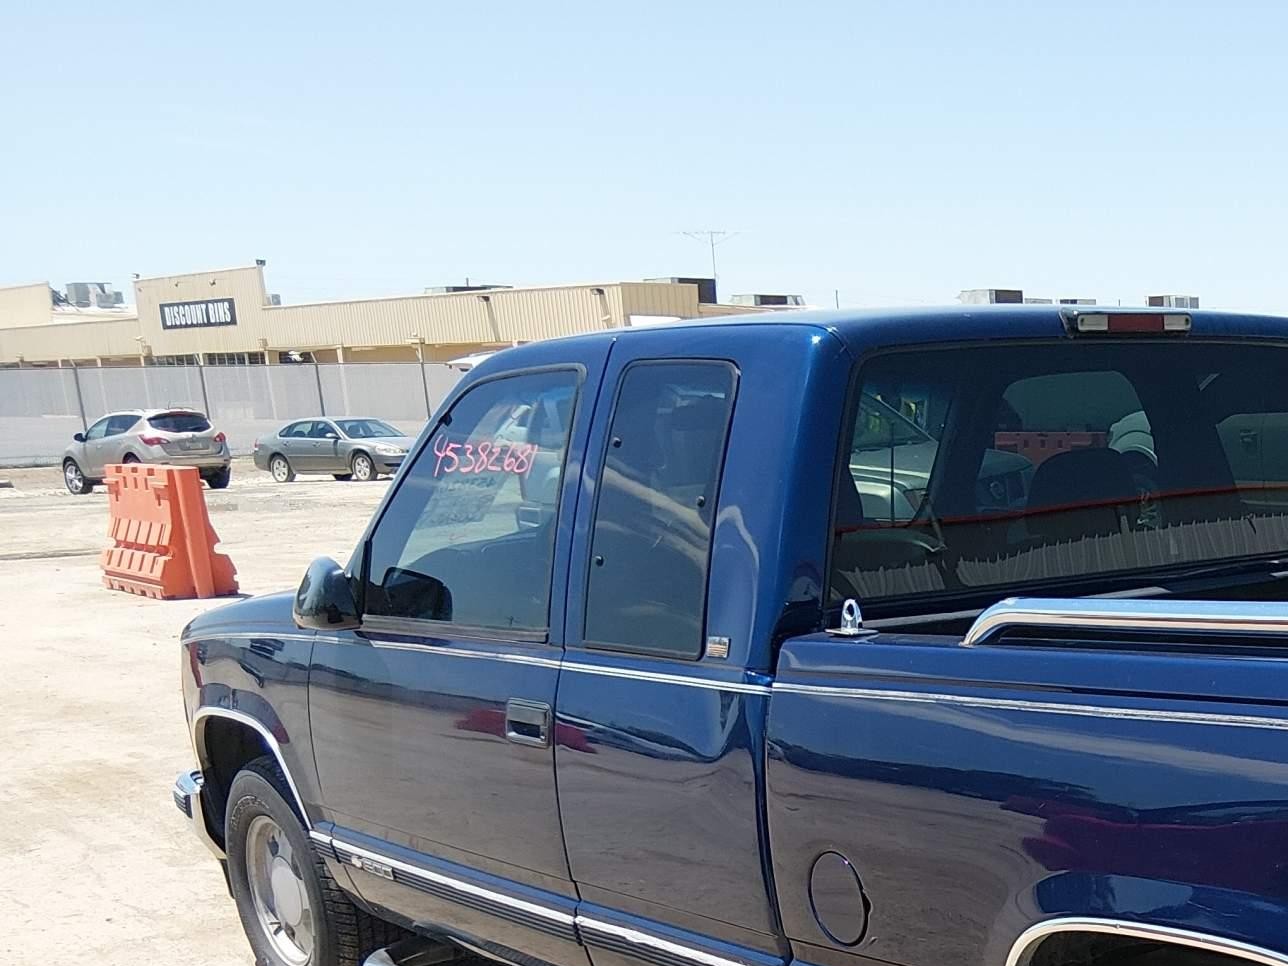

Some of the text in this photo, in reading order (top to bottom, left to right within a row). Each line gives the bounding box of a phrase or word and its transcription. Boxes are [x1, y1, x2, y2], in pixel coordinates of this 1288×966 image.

[164, 301, 231, 326] DISCOUNT BINS
[433, 433, 538, 480] 45382681
